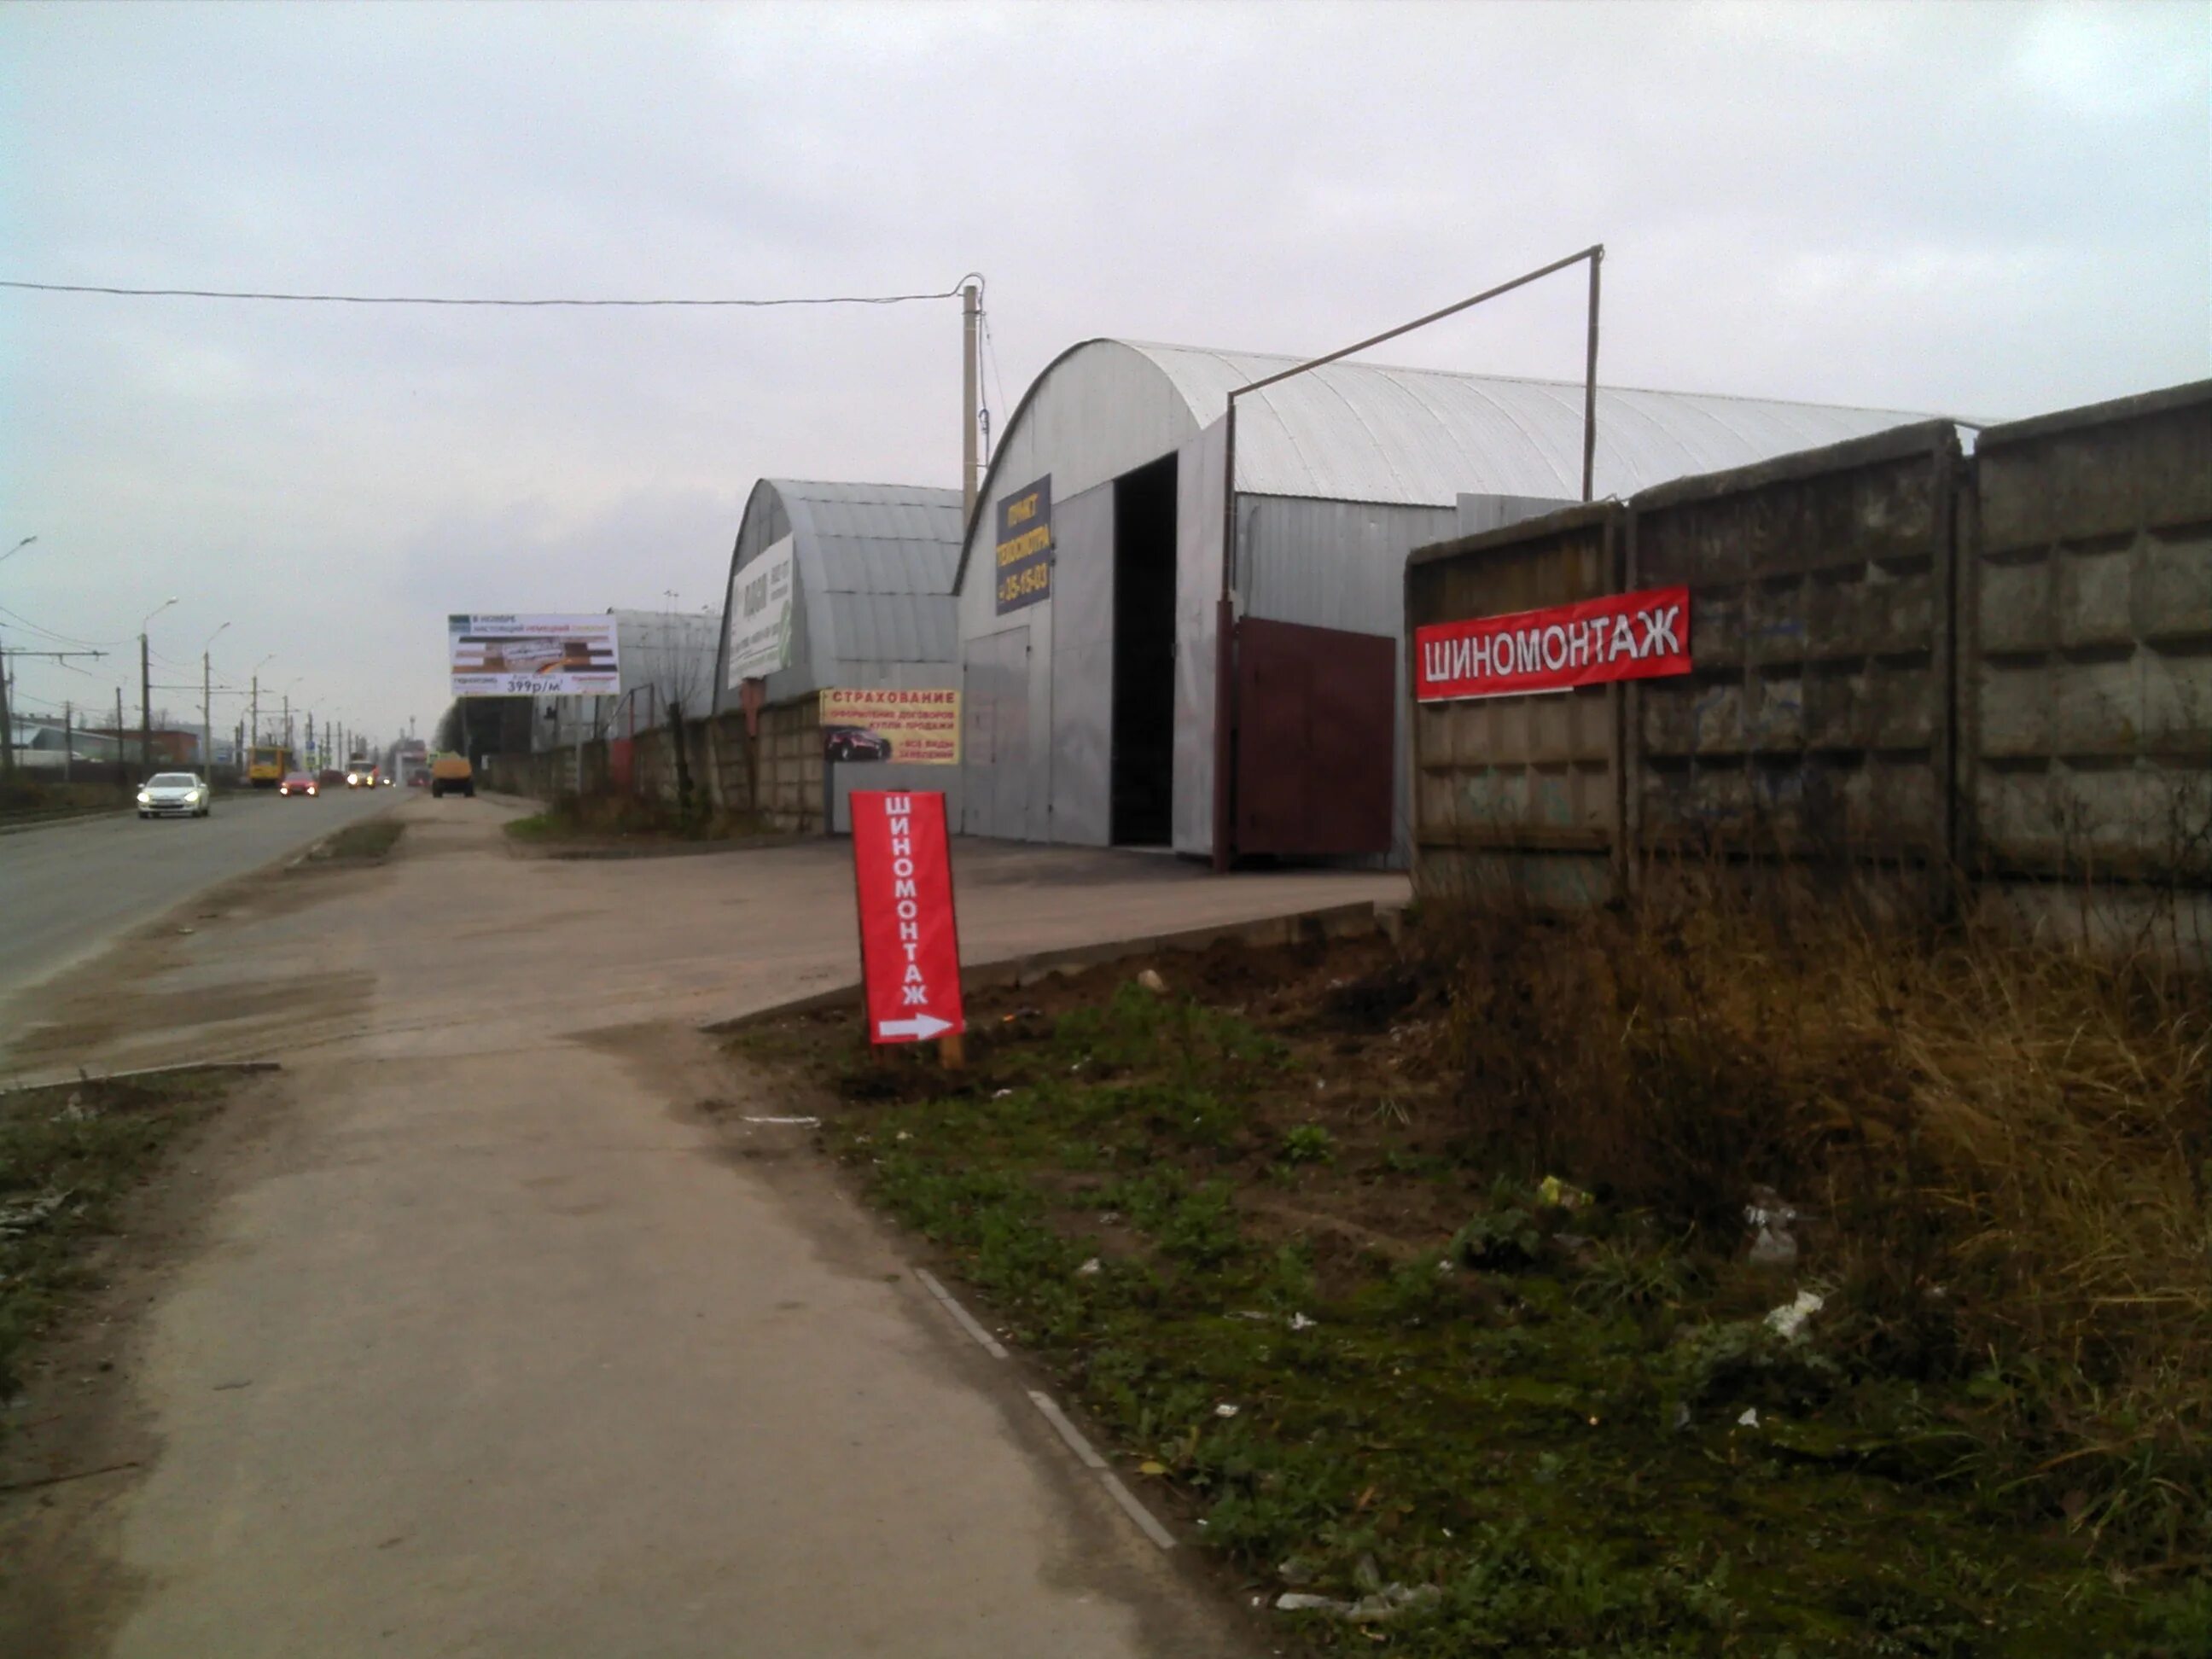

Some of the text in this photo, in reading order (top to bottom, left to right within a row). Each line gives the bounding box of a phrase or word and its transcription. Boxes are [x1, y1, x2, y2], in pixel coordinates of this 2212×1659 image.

[1424, 605, 1680, 683] ШИНОМОНТАЖ
[832, 691, 955, 704] СТРАХОВАНИЕ
[898, 710, 955, 720] ДОГОВОРОВ
[884, 796, 928, 1005] ШИНОМОНТАЖ
